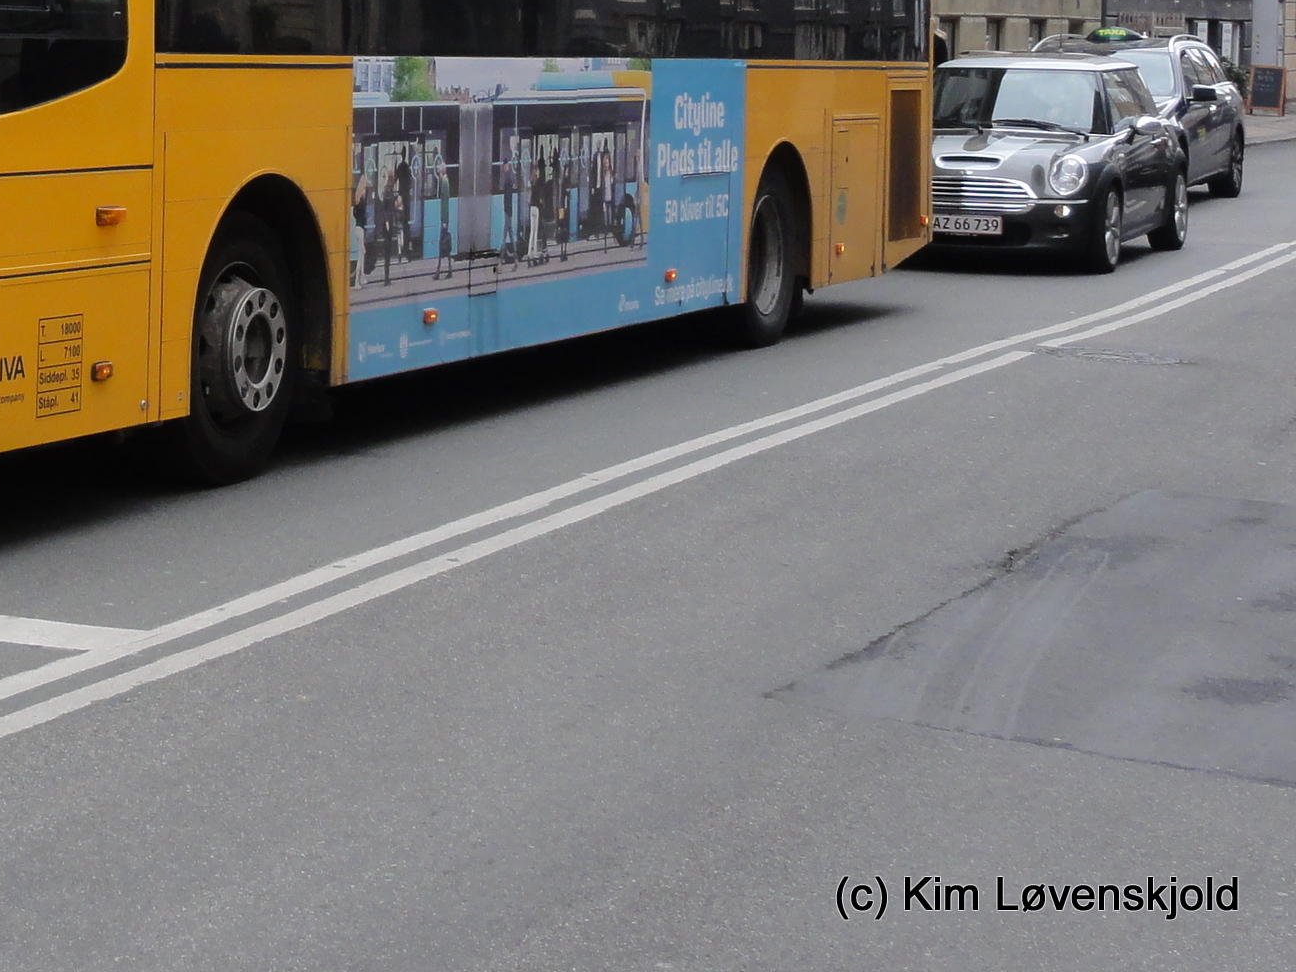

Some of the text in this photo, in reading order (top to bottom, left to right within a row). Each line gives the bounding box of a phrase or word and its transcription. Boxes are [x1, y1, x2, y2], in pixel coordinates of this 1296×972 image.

[1098, 28, 1125, 37] TAXA
[673, 91, 725, 136] Cityline
[656, 138, 739, 178] Plads til alle
[665, 199, 678, 224] 5A
[716, 193, 729, 217] 5C
[934, 217, 999, 232] AZ 66 739
[60, 321, 82, 335] 18000
[64, 345, 81, 359] 7100
[71, 368, 80, 381] 35
[70, 391, 79, 404] 41
